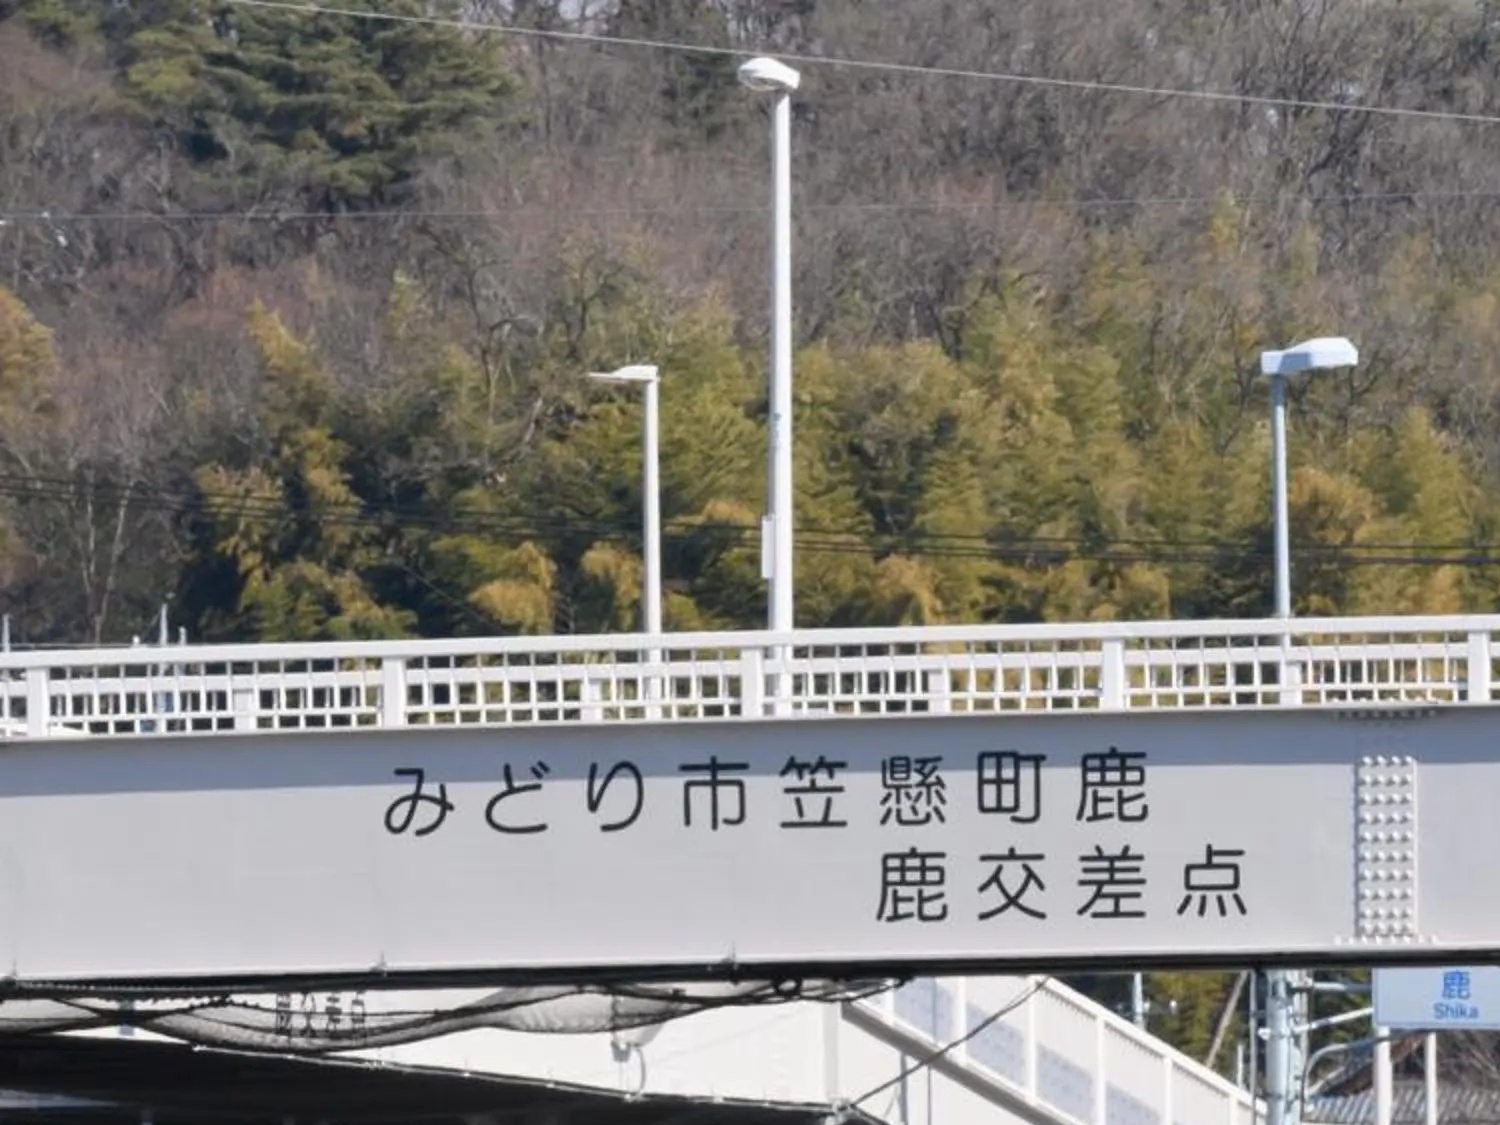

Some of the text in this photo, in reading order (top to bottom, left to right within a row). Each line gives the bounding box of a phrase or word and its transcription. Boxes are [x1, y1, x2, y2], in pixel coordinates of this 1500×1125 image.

[383, 747, 1149, 837] みどり市笠懸町鹿
[876, 844, 1248, 923] 鹿交差点
[1434, 1002, 1479, 1019] Shika
